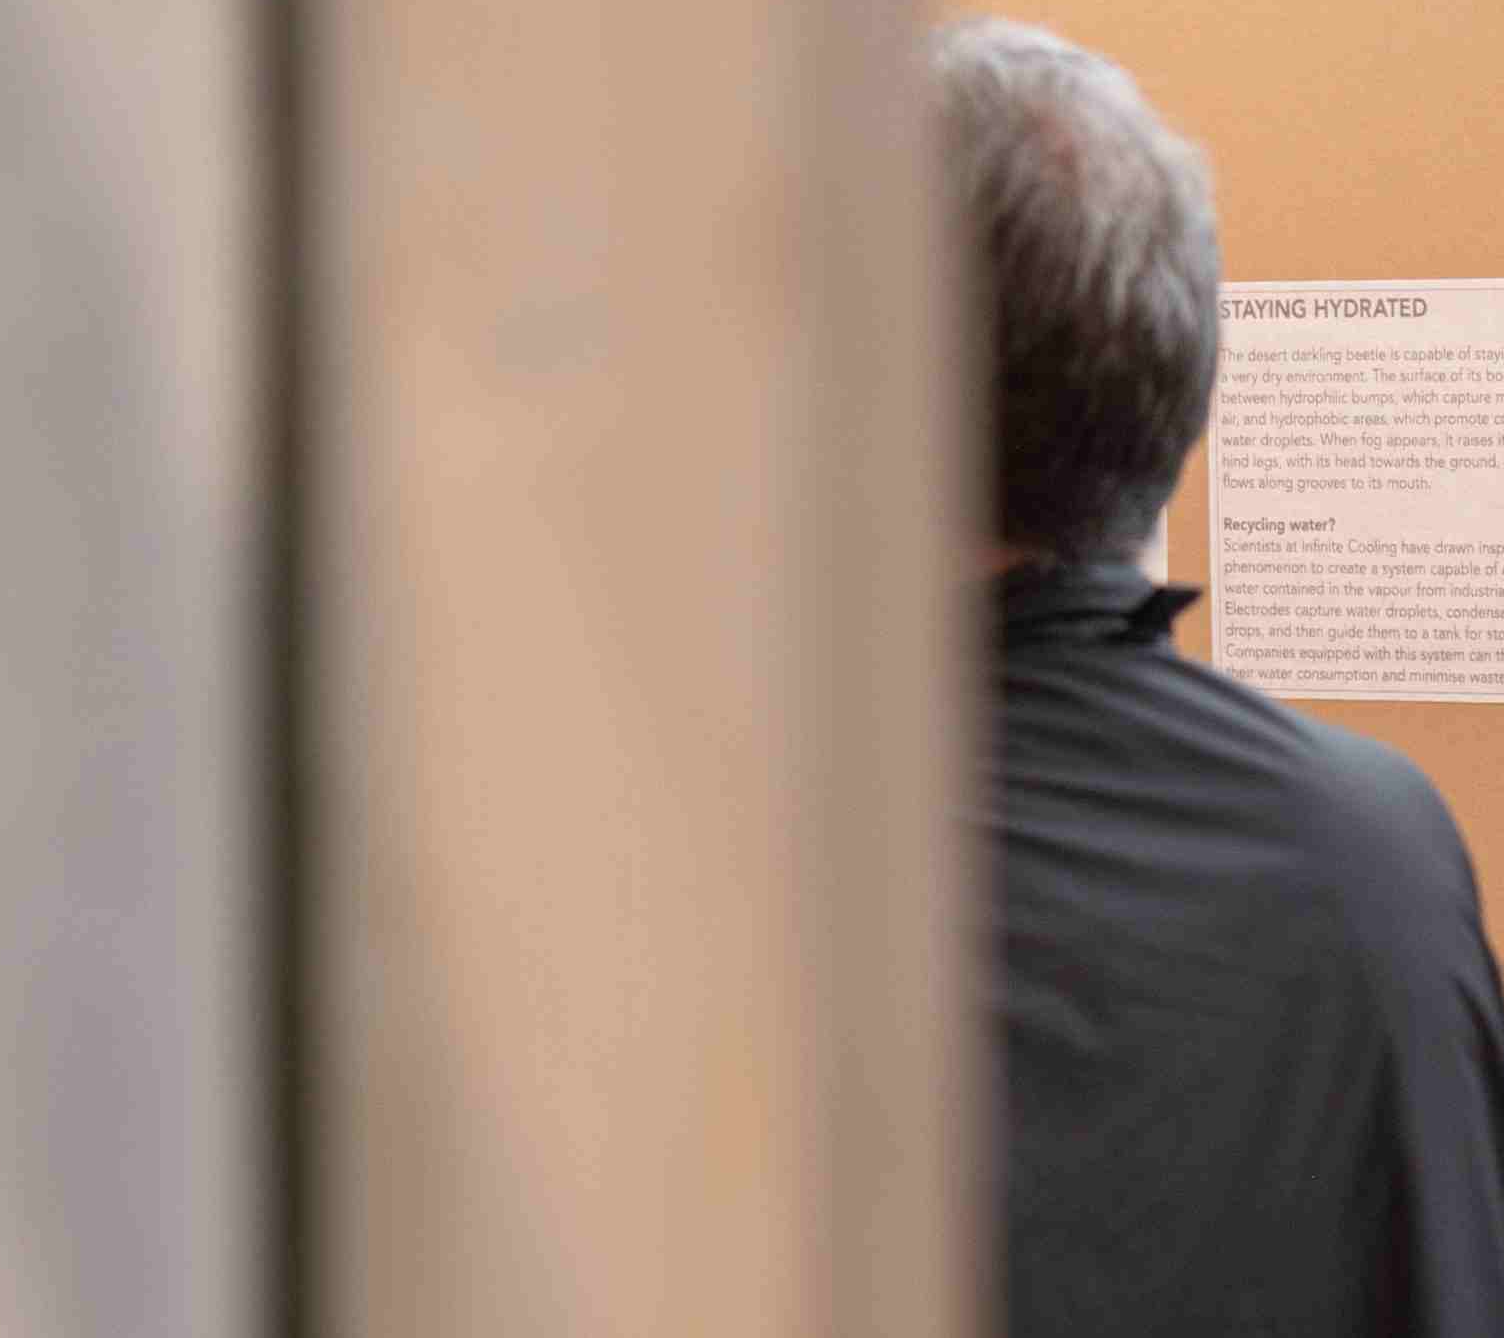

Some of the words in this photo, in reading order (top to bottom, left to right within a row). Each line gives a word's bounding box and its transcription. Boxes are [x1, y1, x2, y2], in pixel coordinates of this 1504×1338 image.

[1218, 298, 1307, 321] STAYING
[1313, 297, 1429, 319] HYDRATED
[1222, 516, 1286, 536] Recycling
[1288, 517, 1337, 533] water?
